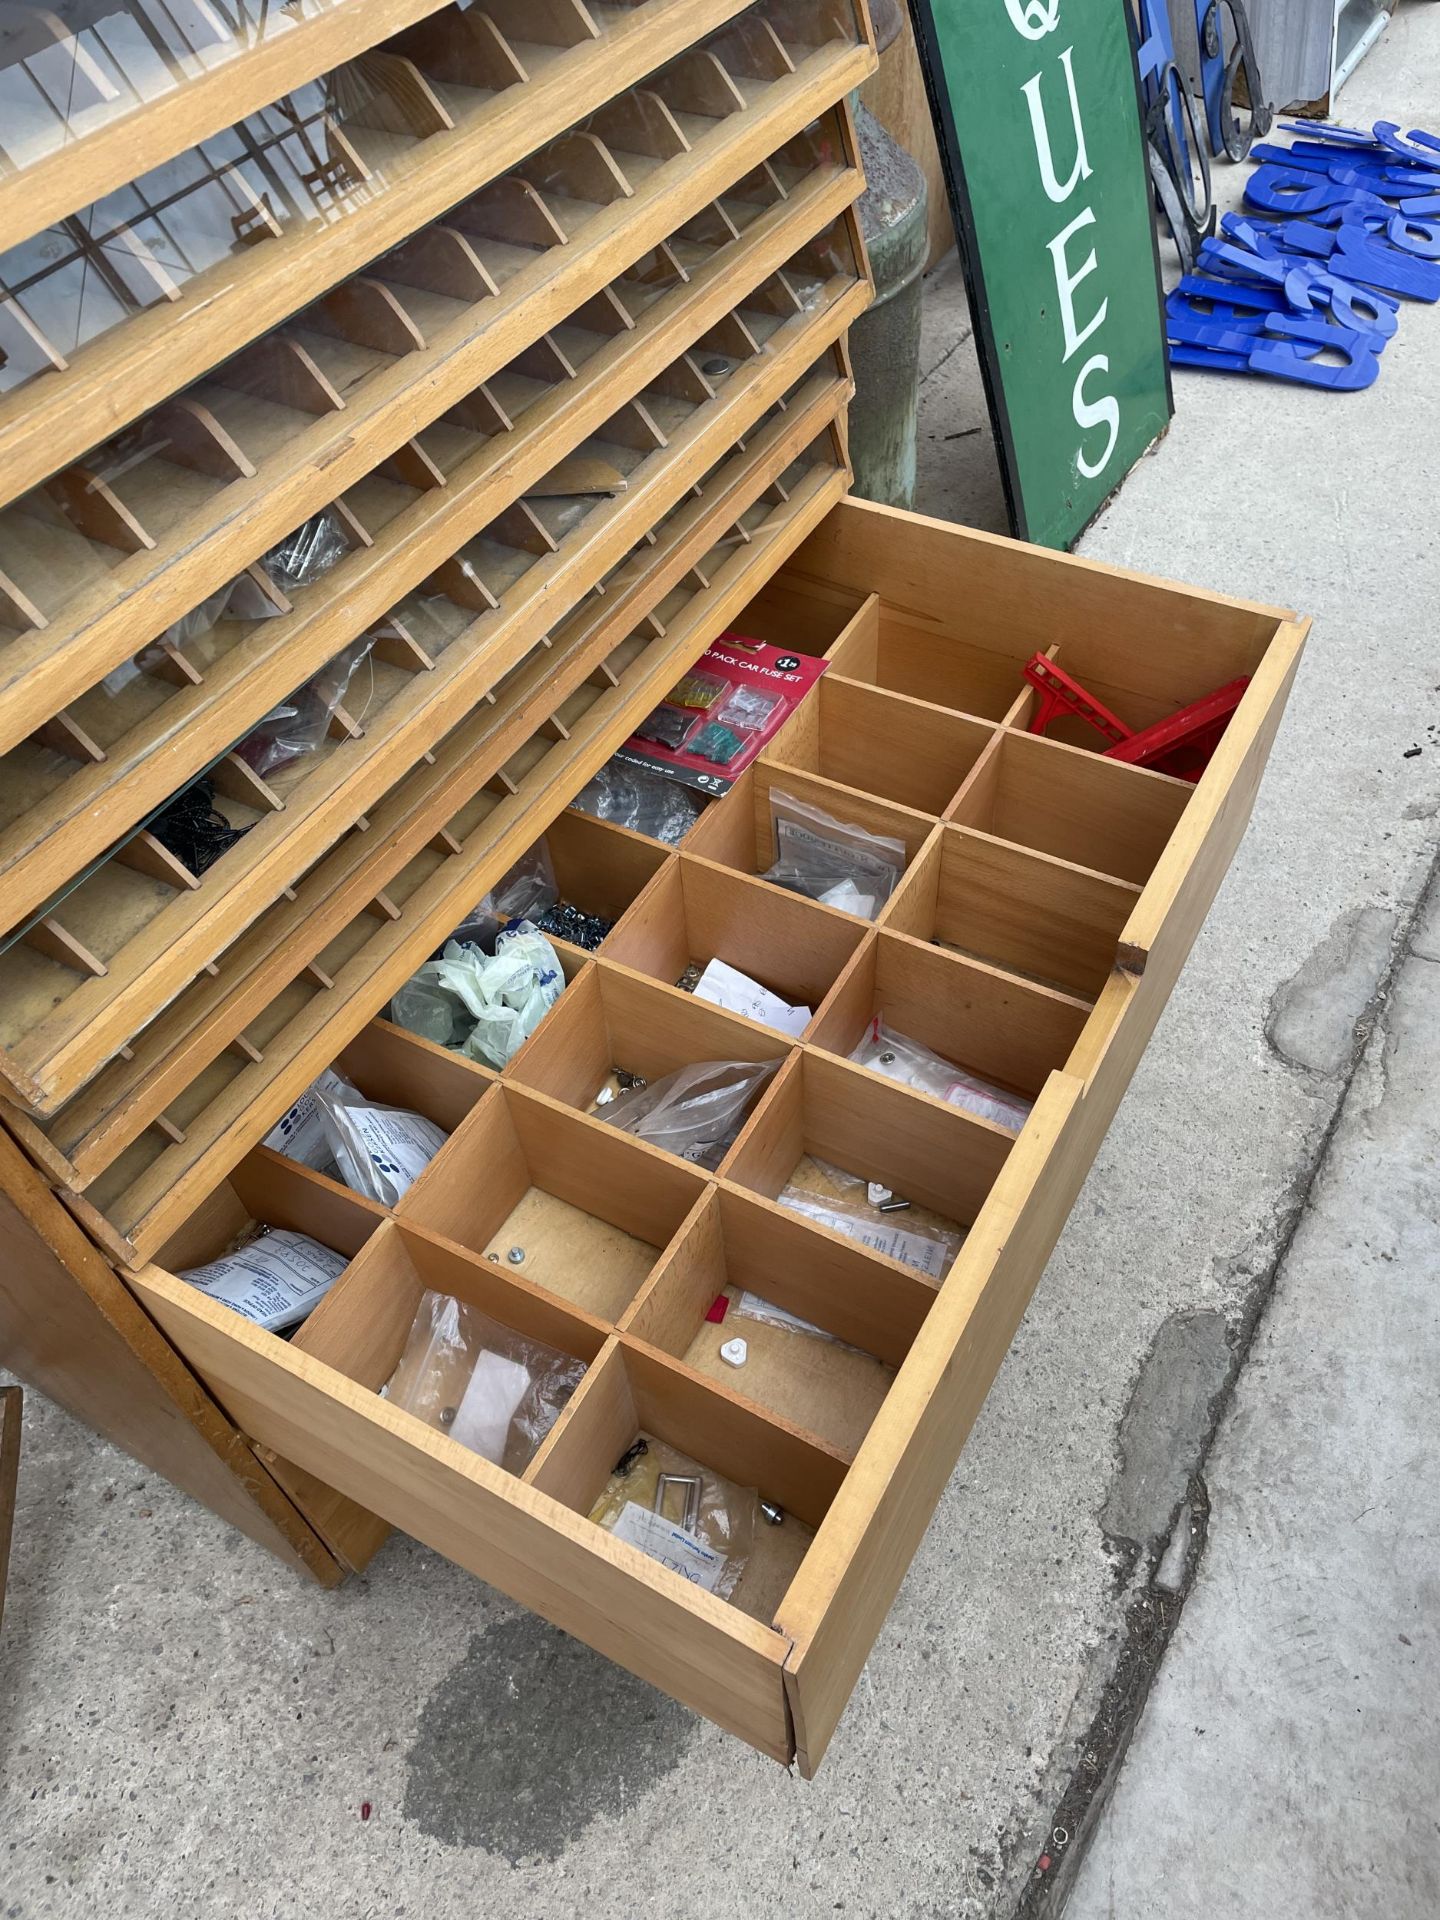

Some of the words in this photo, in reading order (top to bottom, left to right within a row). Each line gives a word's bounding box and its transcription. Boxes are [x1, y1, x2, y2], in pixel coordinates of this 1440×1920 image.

[1004, 0, 1120, 479] UES
[711, 651, 738, 665] PACK
[738, 661, 760, 673] CAR
[759, 667, 784, 679] FUSE
[783, 673, 803, 683] SET
[624, 756, 643, 765] coded
